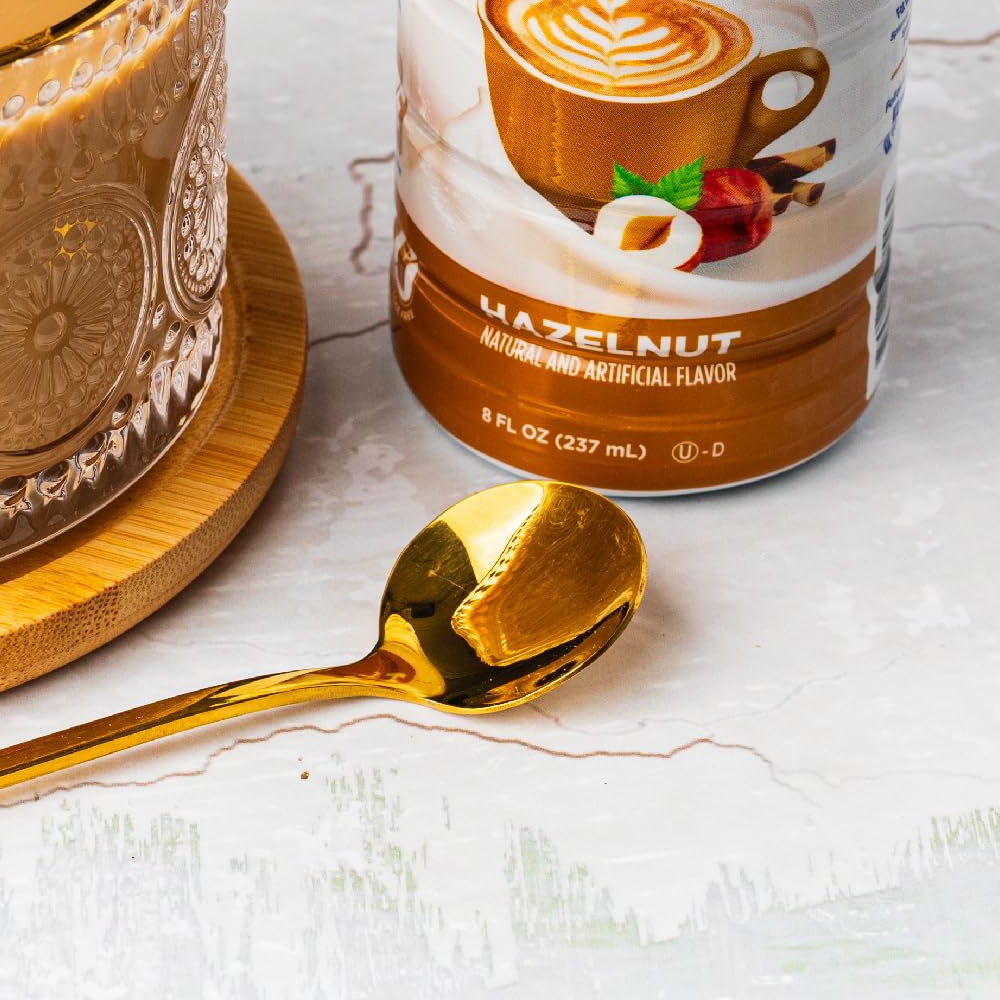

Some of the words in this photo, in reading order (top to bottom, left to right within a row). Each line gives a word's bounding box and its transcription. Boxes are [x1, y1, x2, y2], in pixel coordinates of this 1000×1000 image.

[479, 324, 542, 367] NATURAL
[545, 352, 581, 377] AND
[583, 359, 671, 387] ARTIFICIAL
[676, 362, 737, 387] FLAVOR
[480, 294, 742, 358] HAZELNUT
[481, 406, 492, 423] 8
[495, 413, 517, 434] FL
[521, 424, 549, 444] OZ
[554, 433, 600, 454] (237
[605, 442, 647, 461] mL)
